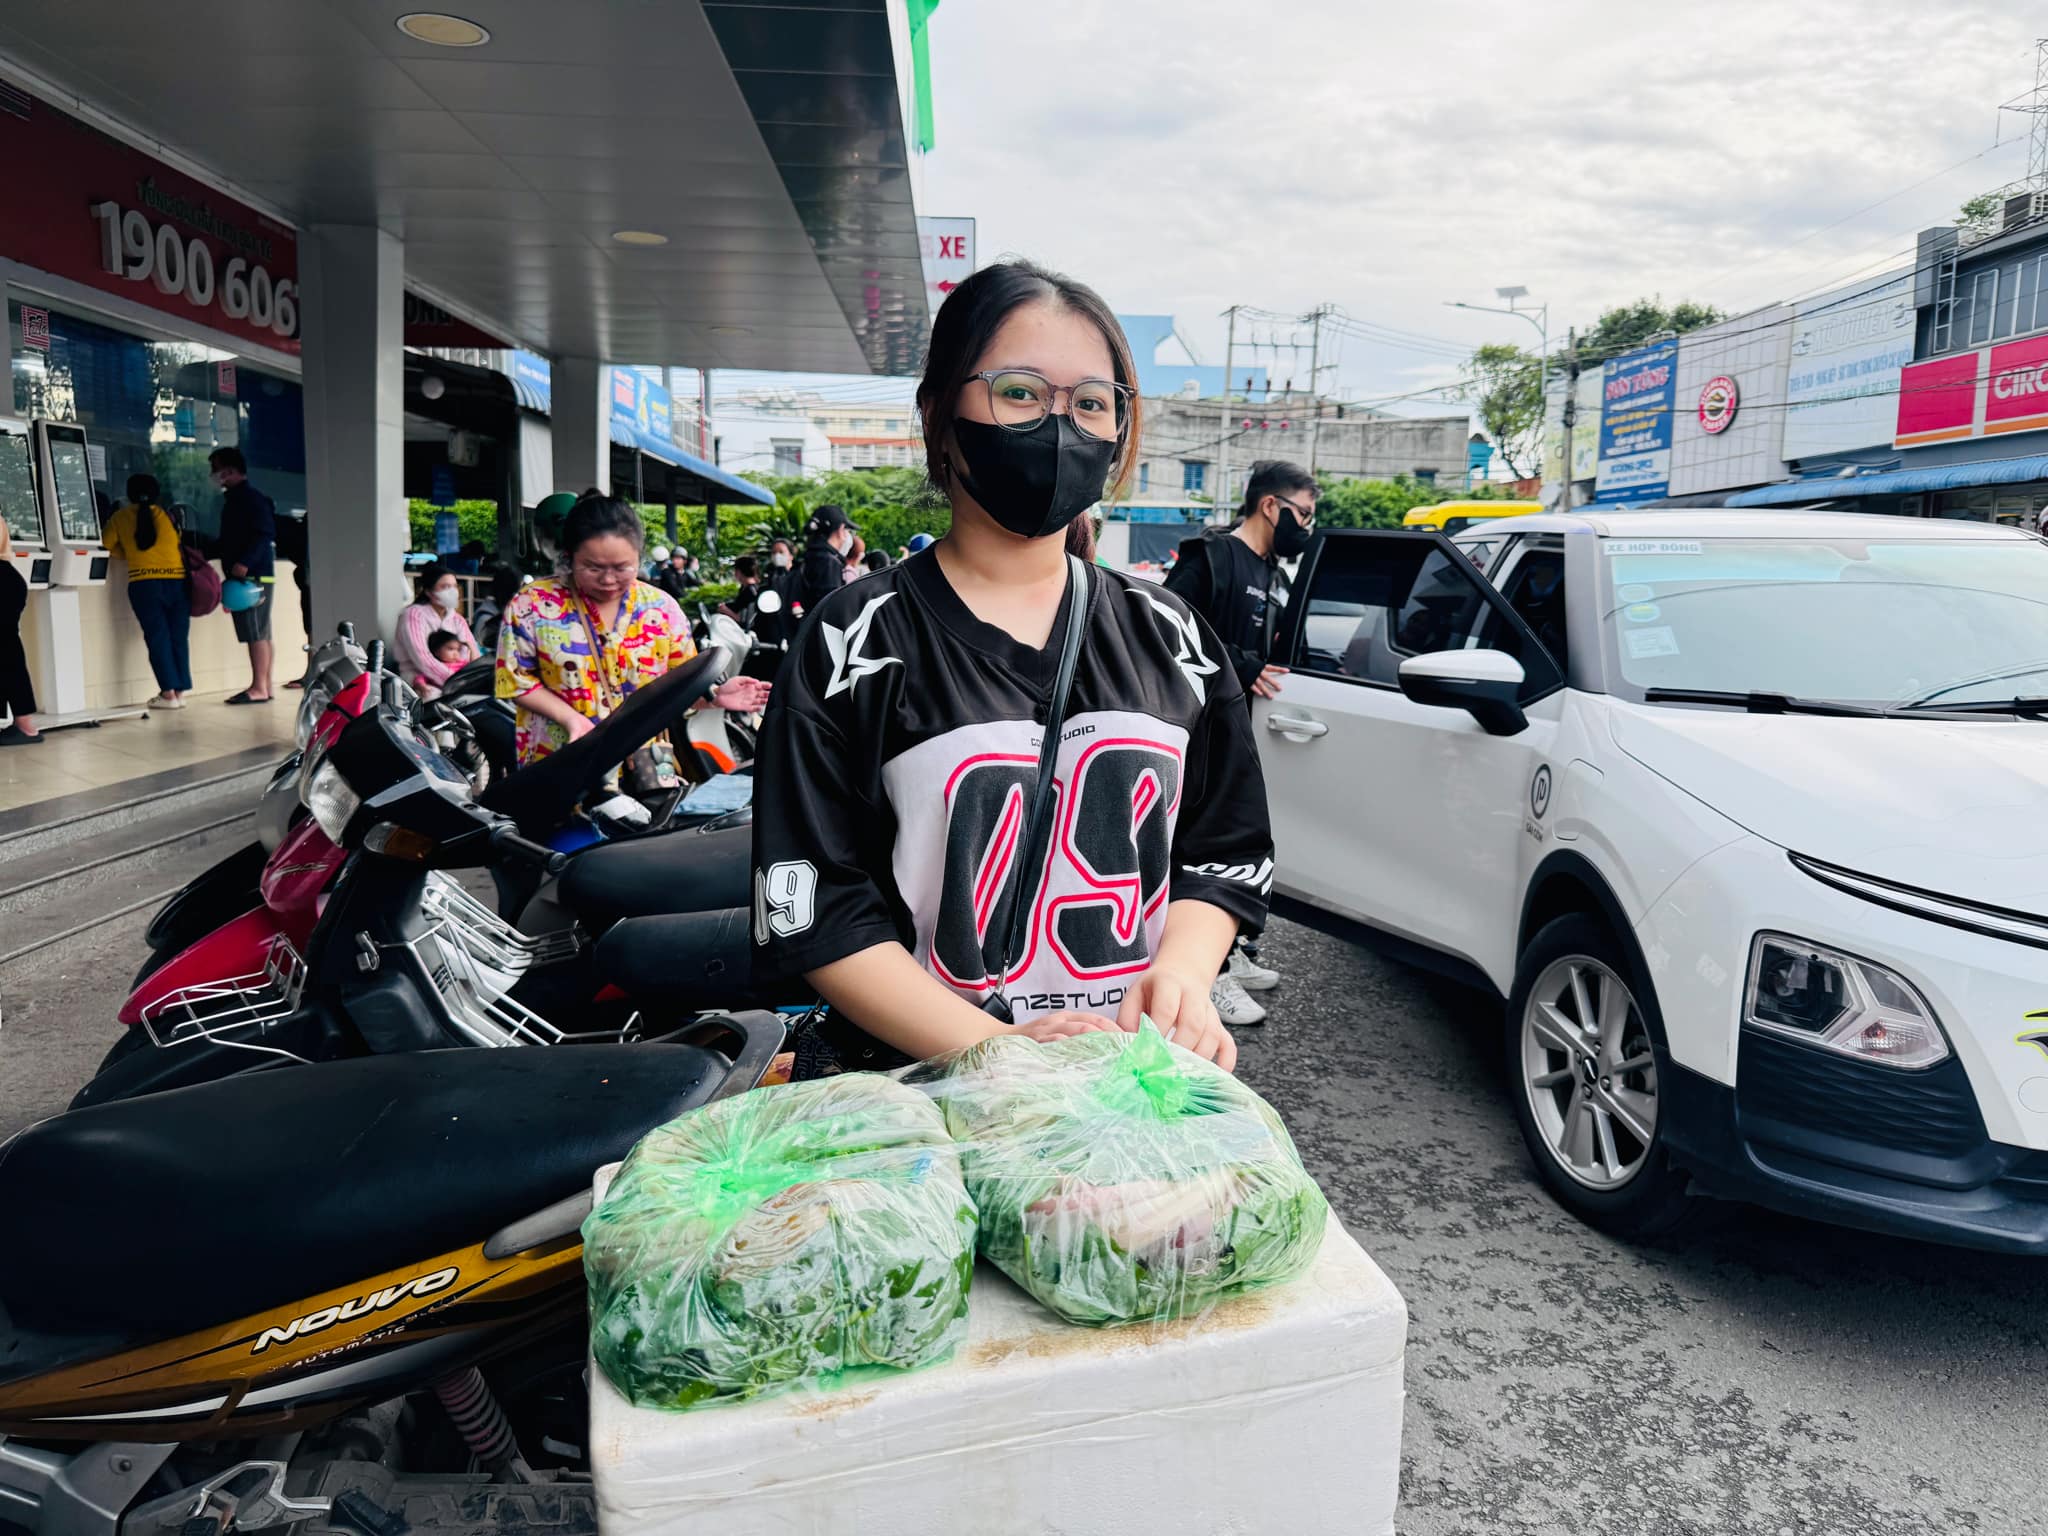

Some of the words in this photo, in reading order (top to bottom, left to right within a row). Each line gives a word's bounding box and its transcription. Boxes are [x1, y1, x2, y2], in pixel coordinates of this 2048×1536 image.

[91, 200, 214, 306] 1900
[221, 257, 299, 337] 606
[939, 235, 965, 258] XE
[252, 1267, 459, 1353] NOUVO
[291, 1325, 406, 1369] AUTOMATIC
